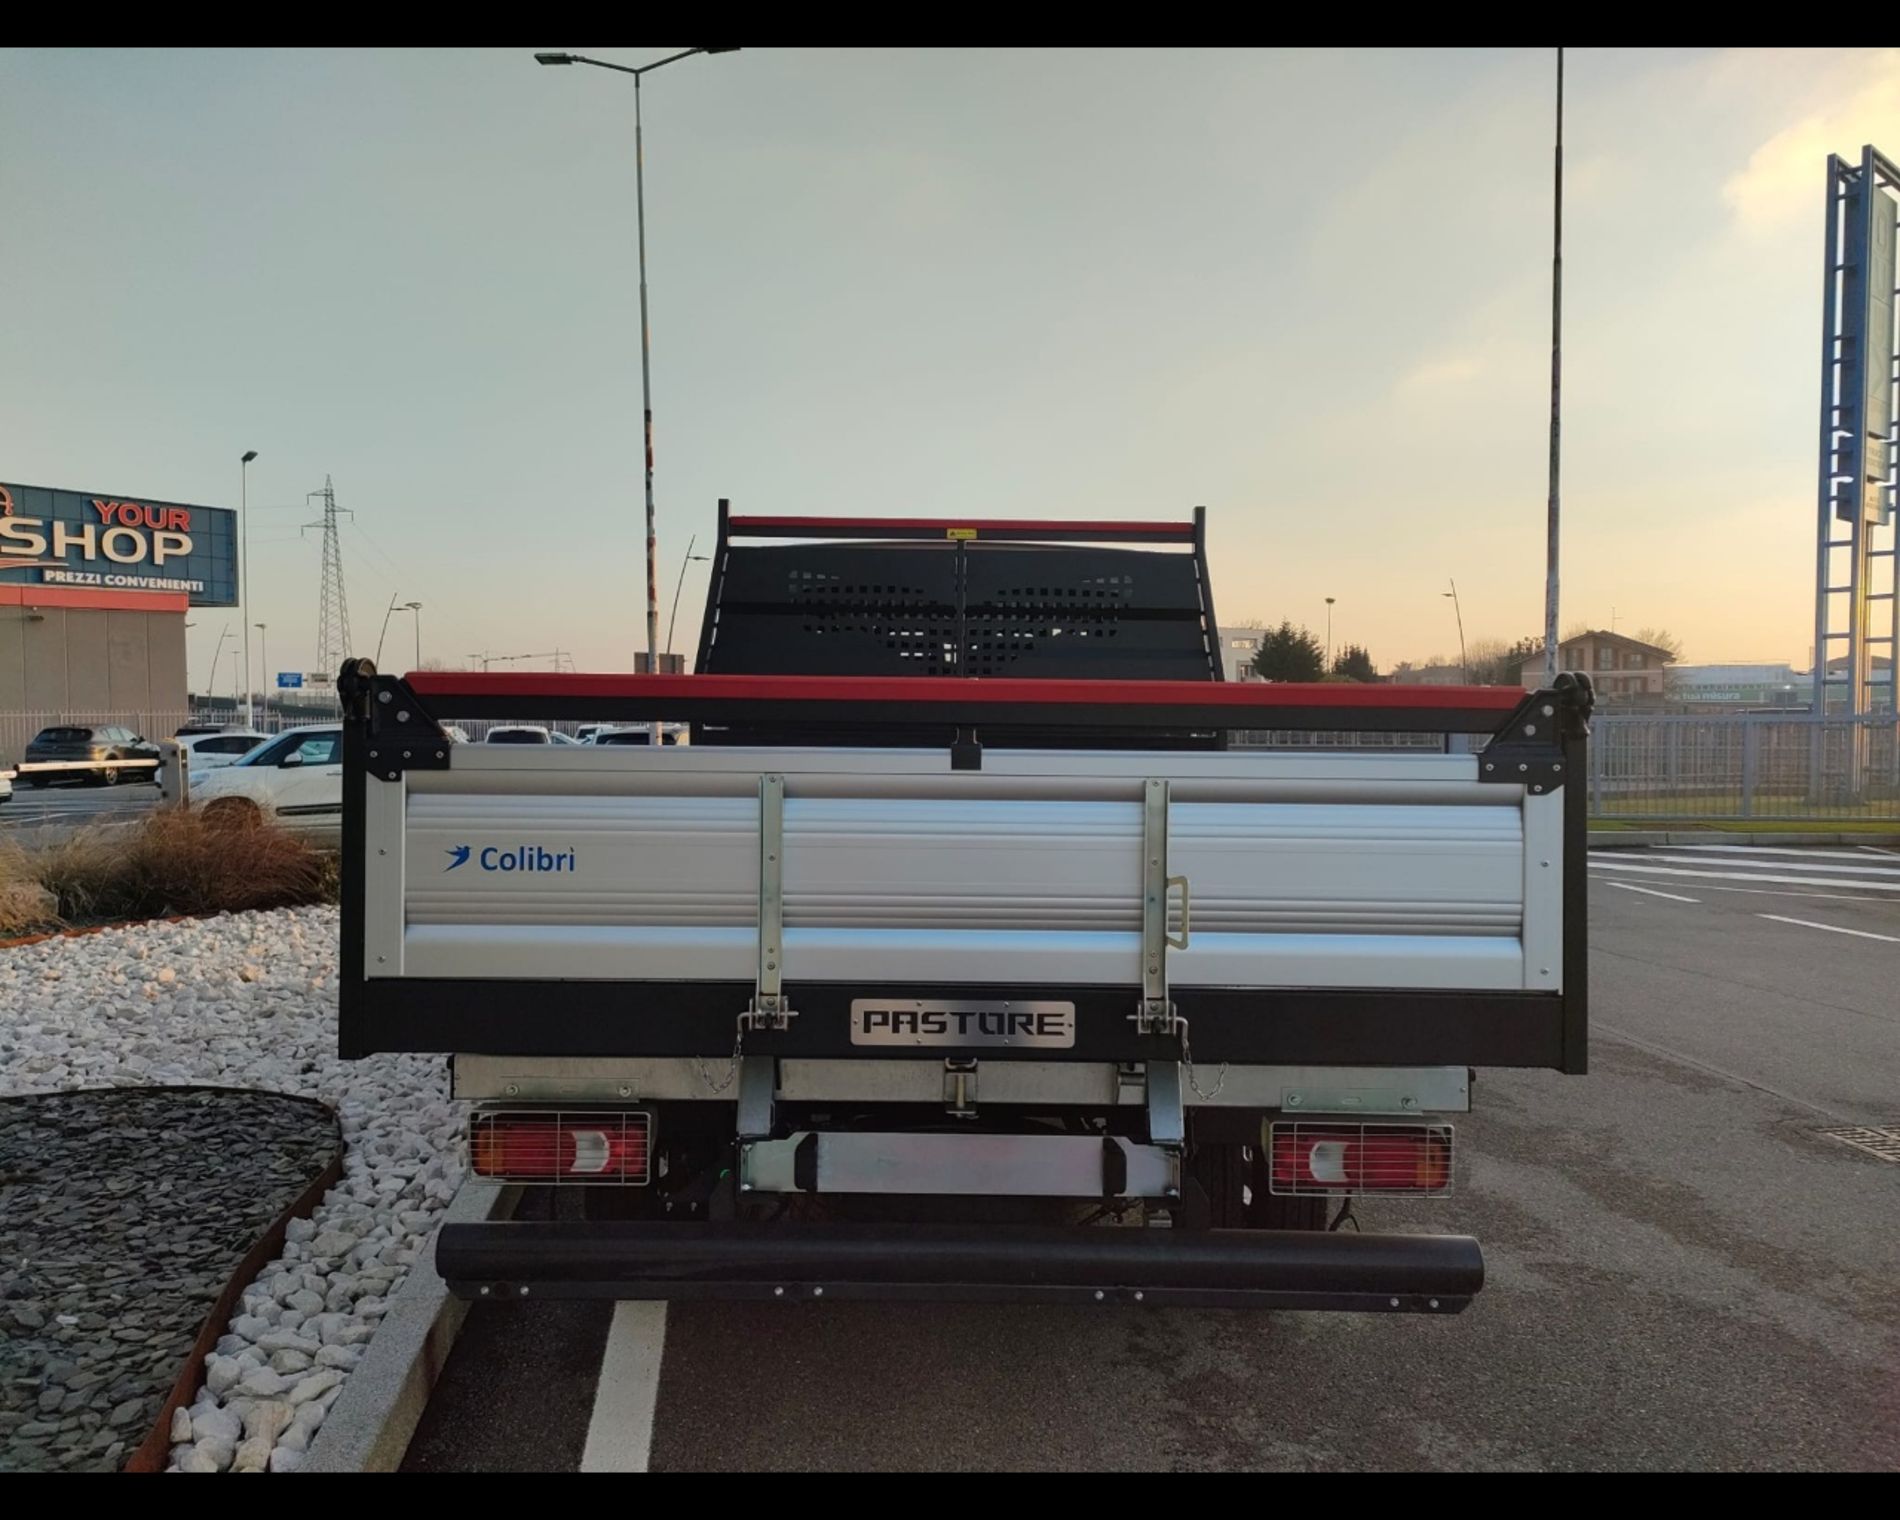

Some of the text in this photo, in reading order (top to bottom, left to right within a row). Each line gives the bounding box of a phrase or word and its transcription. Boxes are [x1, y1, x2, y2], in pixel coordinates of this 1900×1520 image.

[92, 499, 191, 532] YOUR
[0, 516, 193, 565] SHOP
[44, 568, 204, 592] PREZZI CONVENIENTI
[480, 845, 575, 871] Colibrì
[863, 1010, 1066, 1036] PASTORE
